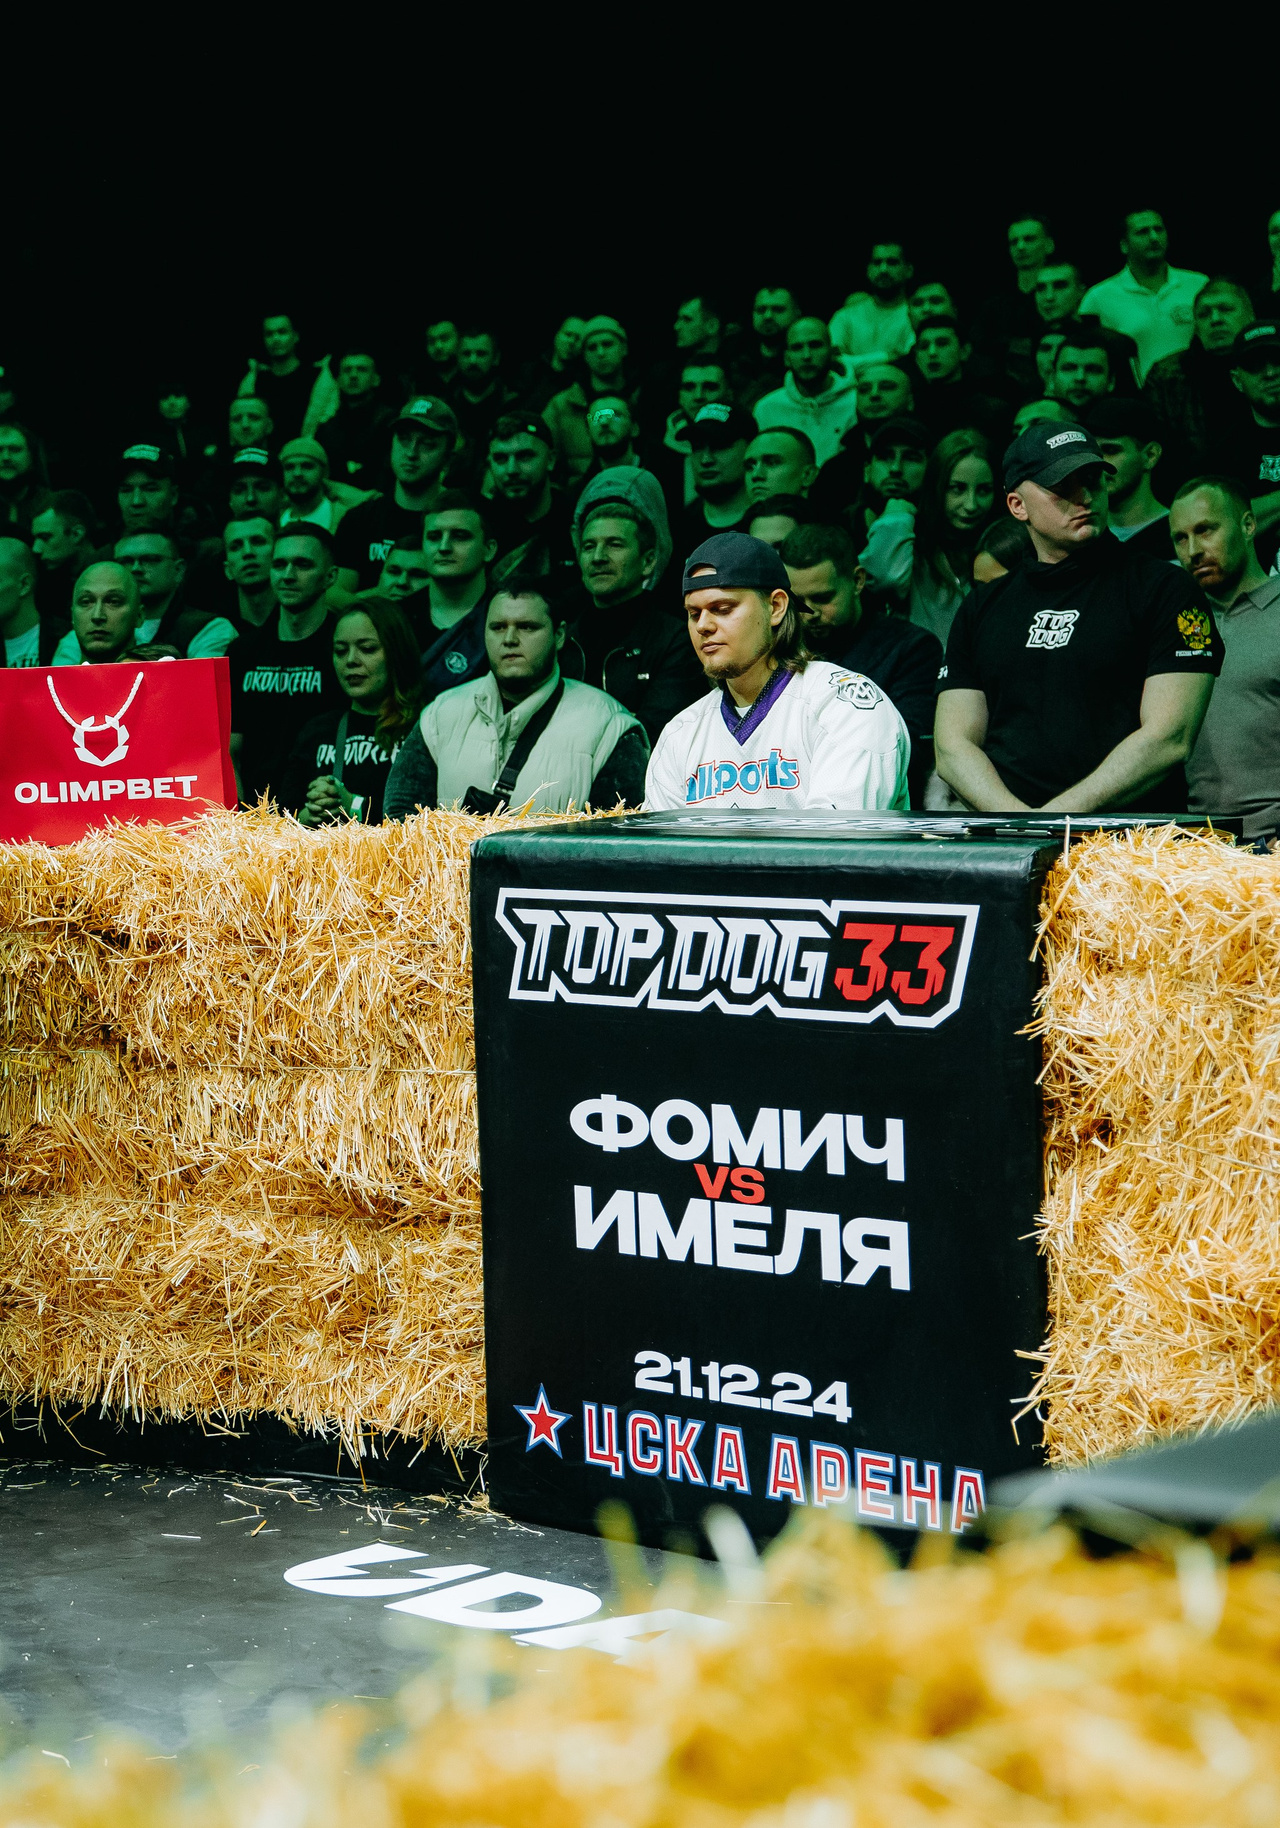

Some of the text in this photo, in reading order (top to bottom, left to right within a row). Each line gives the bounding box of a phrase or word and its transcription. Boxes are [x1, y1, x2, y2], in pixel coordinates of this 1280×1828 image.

[1032, 628, 1070, 645] DOG
[1039, 614, 1075, 630] TOP
[14, 775, 198, 804] OLIMPBET
[834, 922, 956, 1005] 33
[569, 1093, 905, 1182] ФОМИЧ
[692, 1163, 767, 1204] VS
[572, 1184, 912, 1291] ИМЕЛЯ
[633, 1349, 853, 1424] 21.12.24
[581, 1400, 987, 1535] ЦСКА АРЕНА
